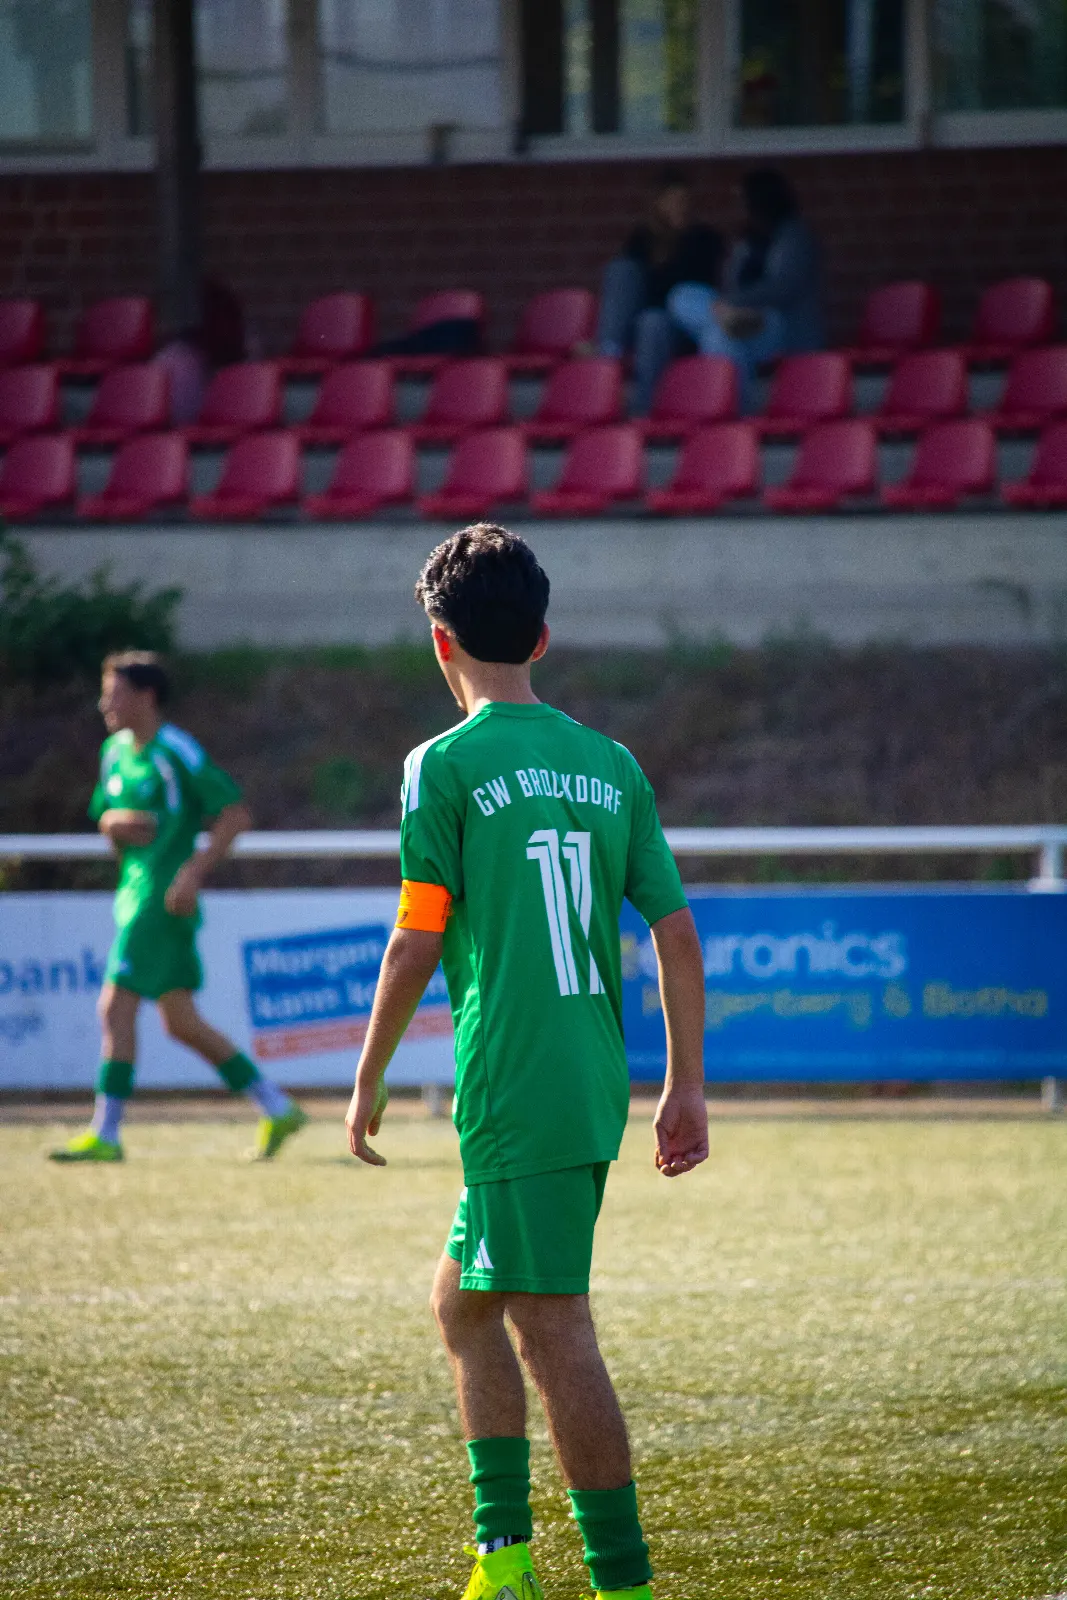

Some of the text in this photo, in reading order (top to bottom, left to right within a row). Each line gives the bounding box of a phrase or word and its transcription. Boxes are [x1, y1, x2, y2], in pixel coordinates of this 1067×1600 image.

[472, 768, 622, 816] GW BROCKDORF
[526, 829, 605, 996] 11
